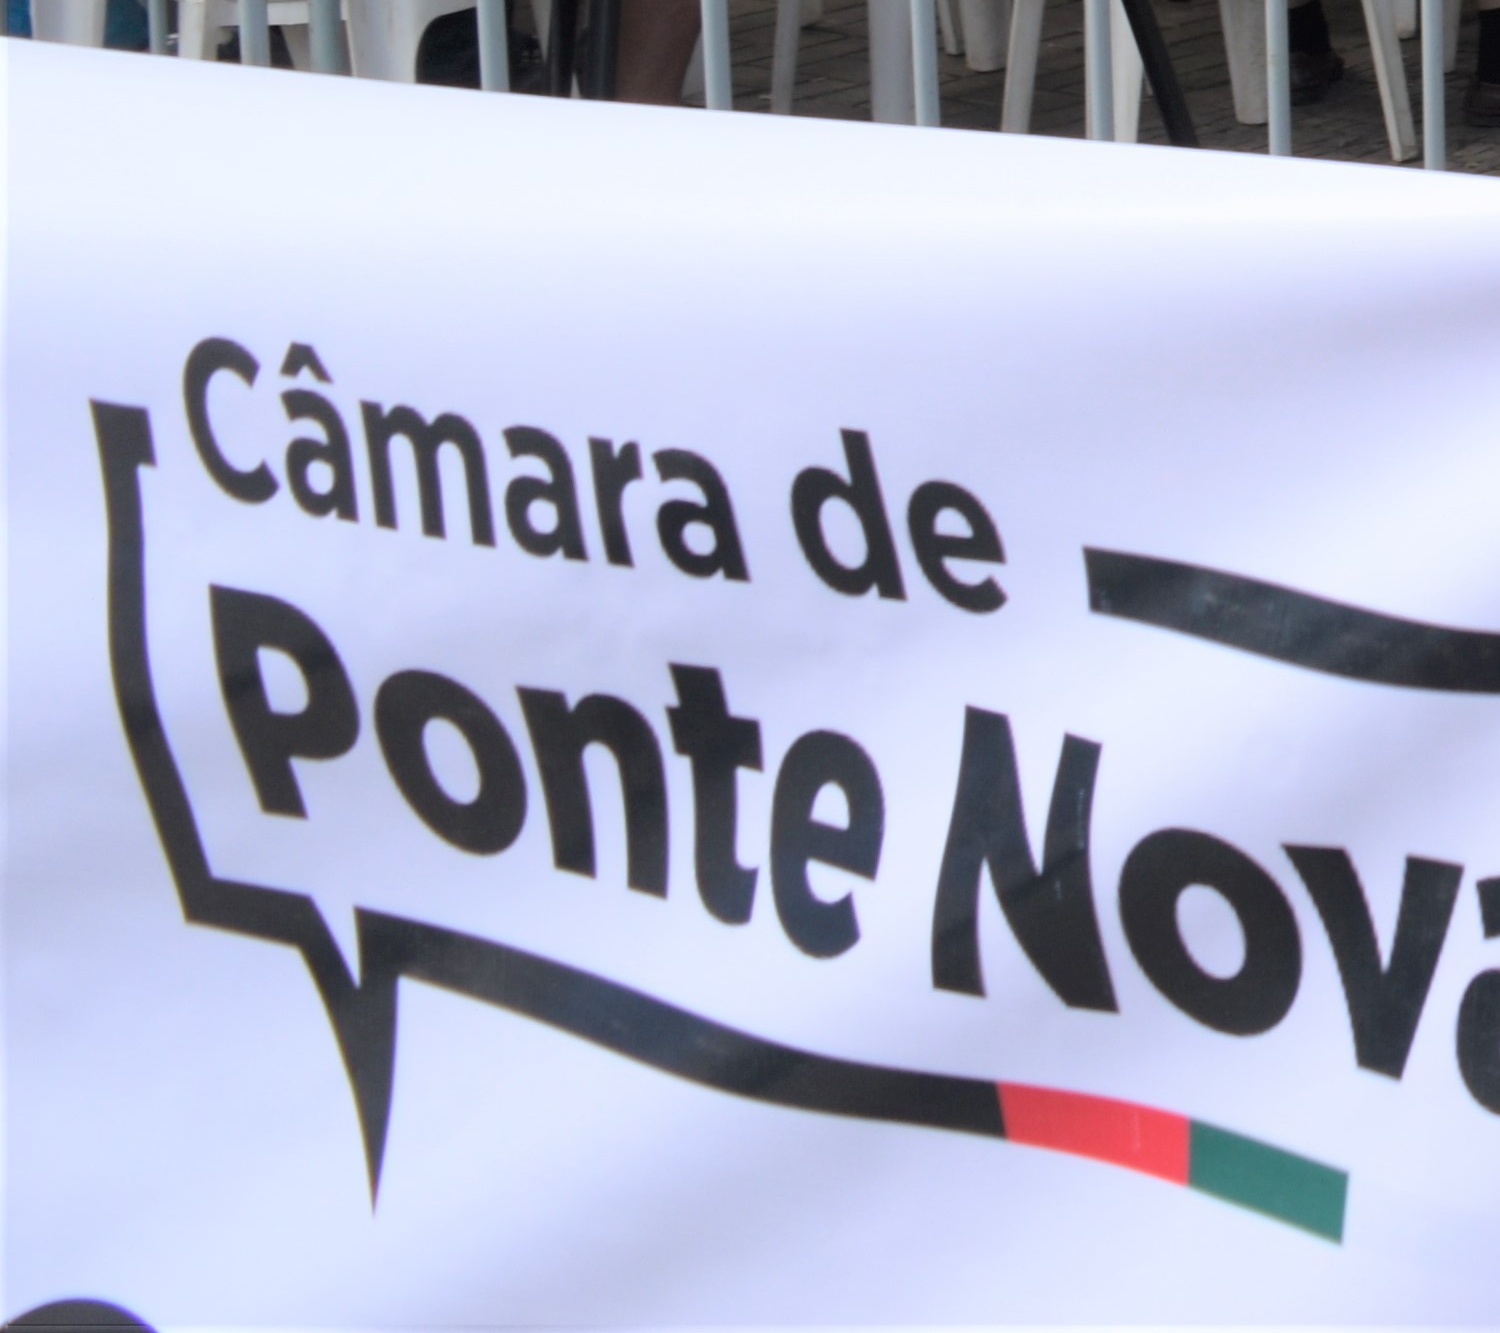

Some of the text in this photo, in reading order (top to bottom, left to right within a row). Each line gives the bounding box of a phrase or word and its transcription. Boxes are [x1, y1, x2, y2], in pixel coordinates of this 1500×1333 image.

[182, 336, 1009, 615] Câmara de
[208, 581, 885, 960] Ponte
